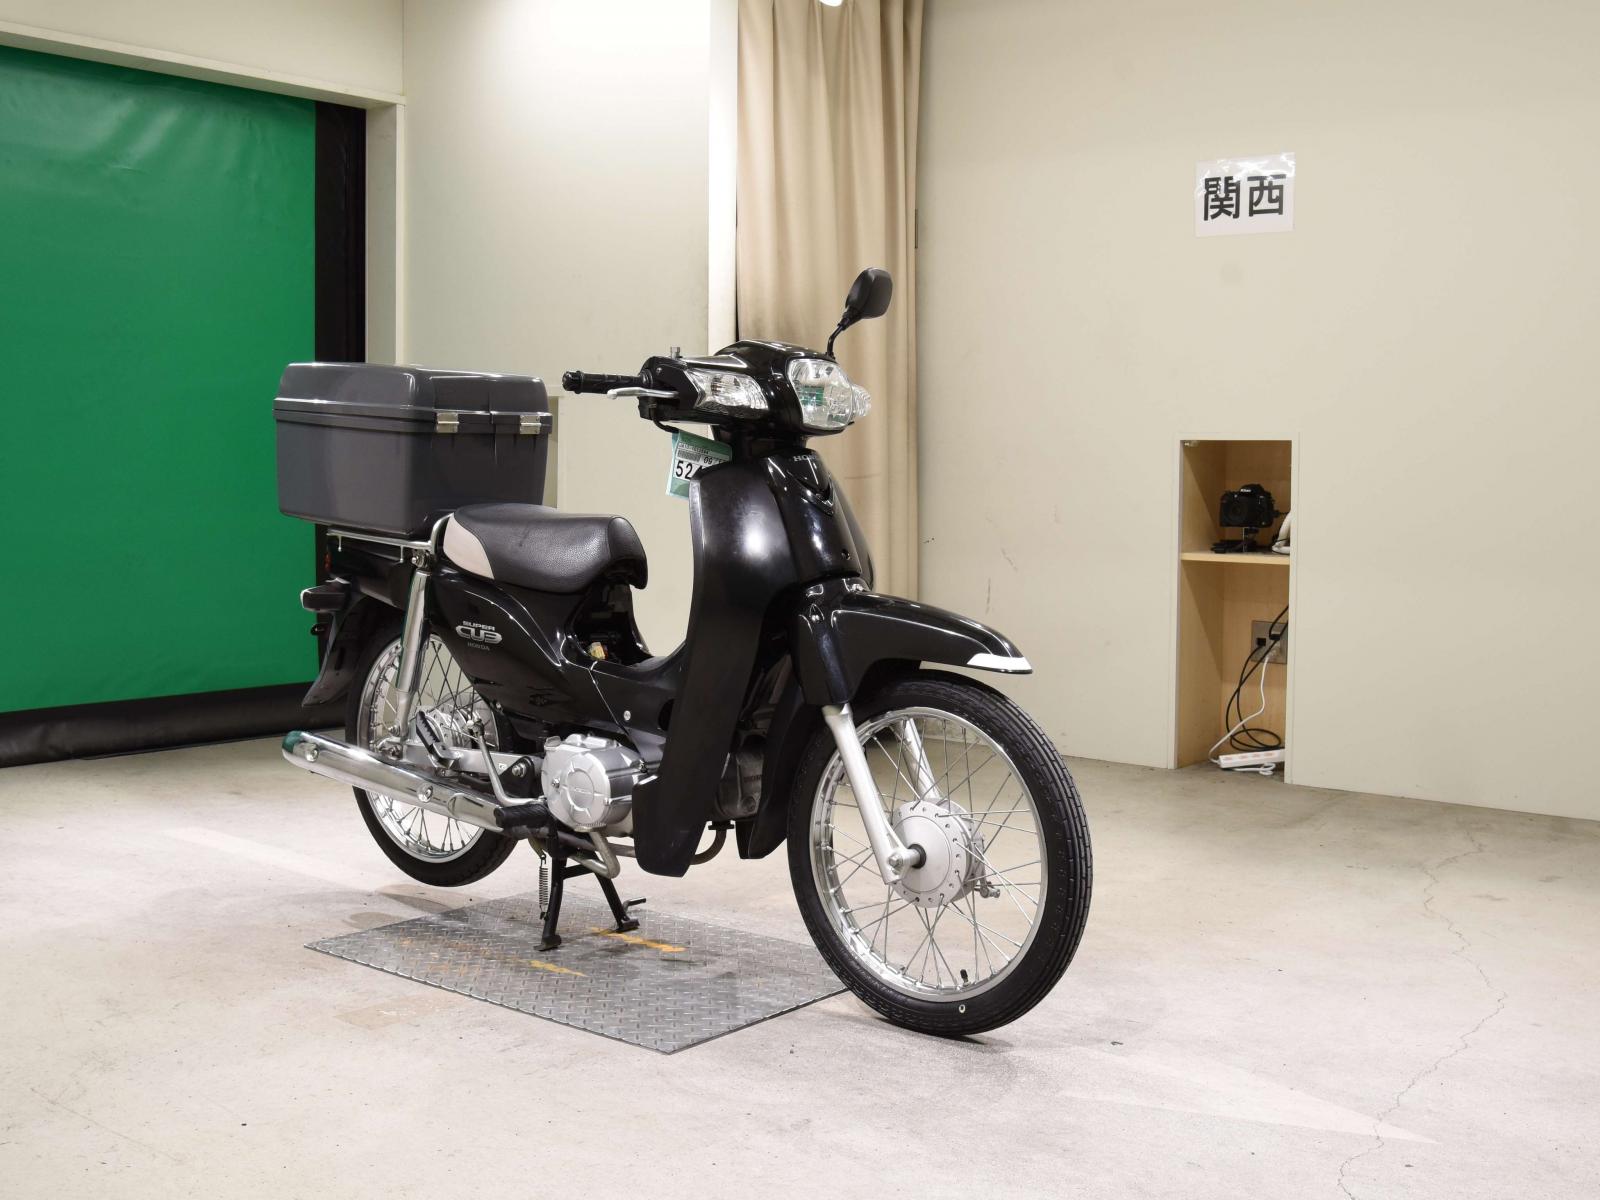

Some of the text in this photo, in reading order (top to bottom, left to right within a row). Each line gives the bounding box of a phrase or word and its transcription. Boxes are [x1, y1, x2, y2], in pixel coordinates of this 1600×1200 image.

[1203, 174, 1287, 221] 関西
[676, 460, 701, 480] 52
[455, 625, 502, 645] CUB
[462, 620, 495, 631] SUPER
[467, 641, 490, 651] HONDA
